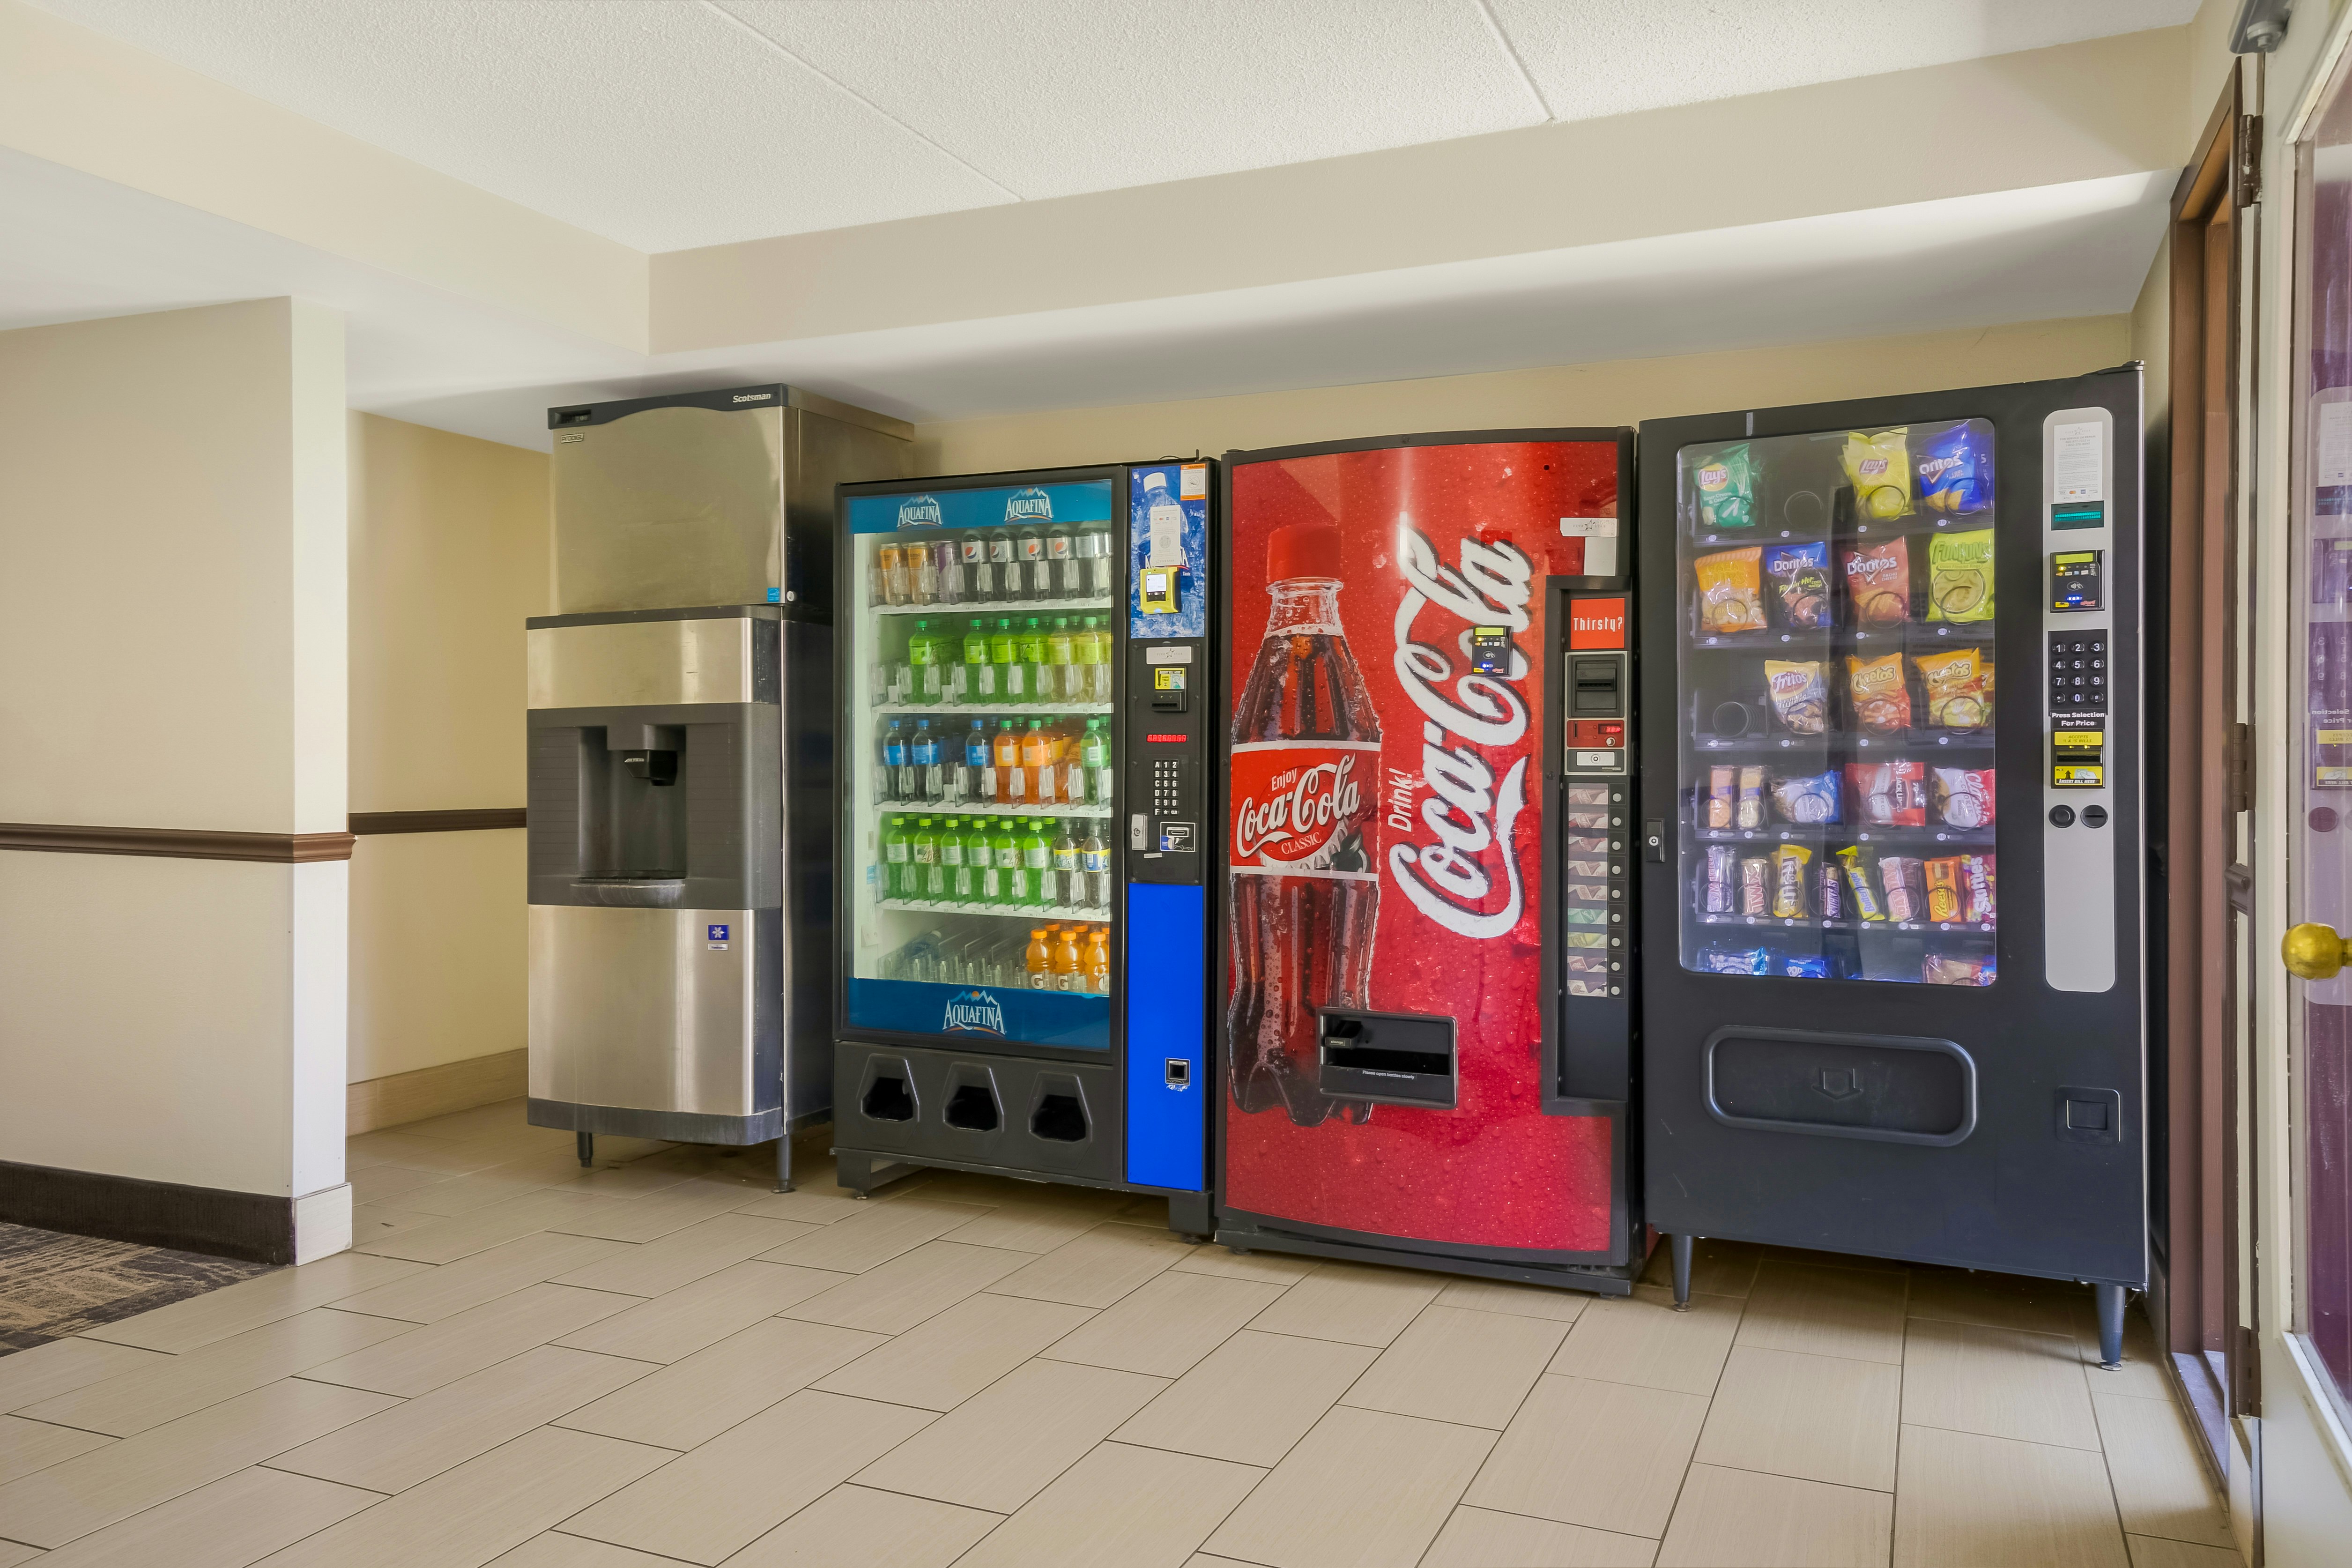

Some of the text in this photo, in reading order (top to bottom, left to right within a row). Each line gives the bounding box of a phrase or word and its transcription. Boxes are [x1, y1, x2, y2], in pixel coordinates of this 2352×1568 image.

[733, 394, 771, 403] Scotsman
[897, 505, 941, 528] AQUAFINA
[1004, 496, 1053, 522] AQUAFINA
[1774, 557, 1814, 572] Doritos
[1847, 557, 1897, 575] Doritos
[1801, 576, 1814, 585] Hot
[1573, 616, 1623, 632] Thirsty?
[1772, 671, 1807, 692] Fritos
[1852, 666, 1894, 695] Cheetos
[1389, 524, 1534, 939] Coca-Cola
[1271, 767, 1298, 792] Enjoy
[1237, 752, 1361, 857] Coca-Cola
[1387, 767, 1414, 832] Drink!
[1280, 831, 1322, 855] CLASSIC
[942, 999, 1007, 1036] AQUAFINA
